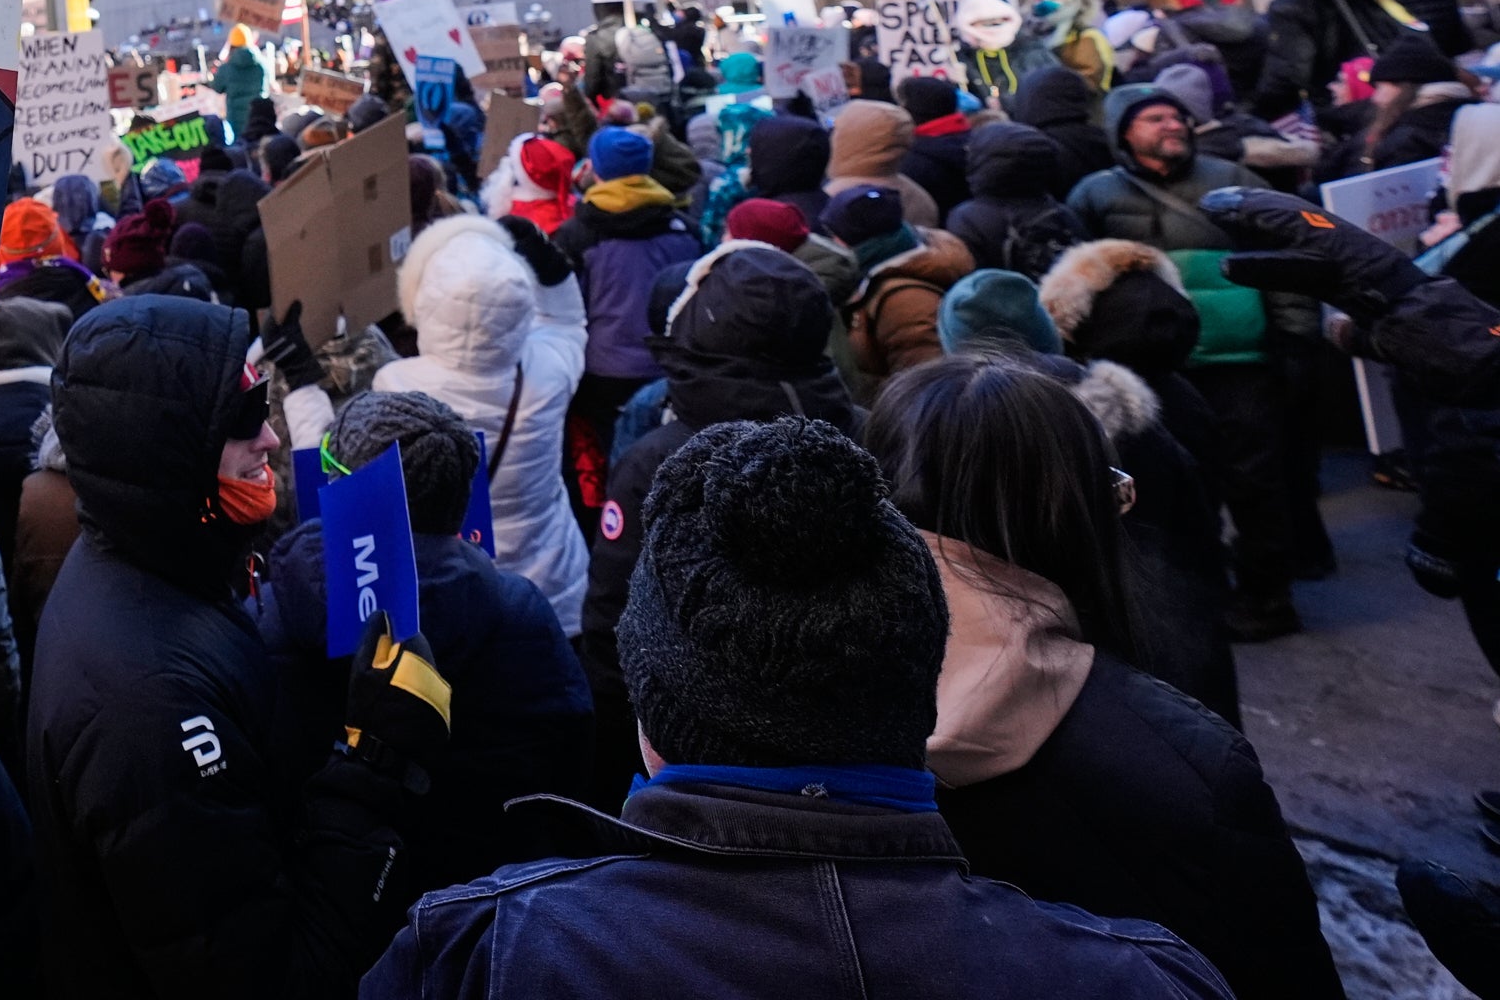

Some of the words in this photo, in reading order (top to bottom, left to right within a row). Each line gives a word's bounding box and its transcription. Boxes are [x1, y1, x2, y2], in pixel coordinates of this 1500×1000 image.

[21, 35, 77, 58] WHEN
[20, 54, 104, 81] YRANNY
[18, 80, 75, 100] ECOMES
[23, 126, 99, 150] BECOMES
[33, 148, 94, 179] DUTY
